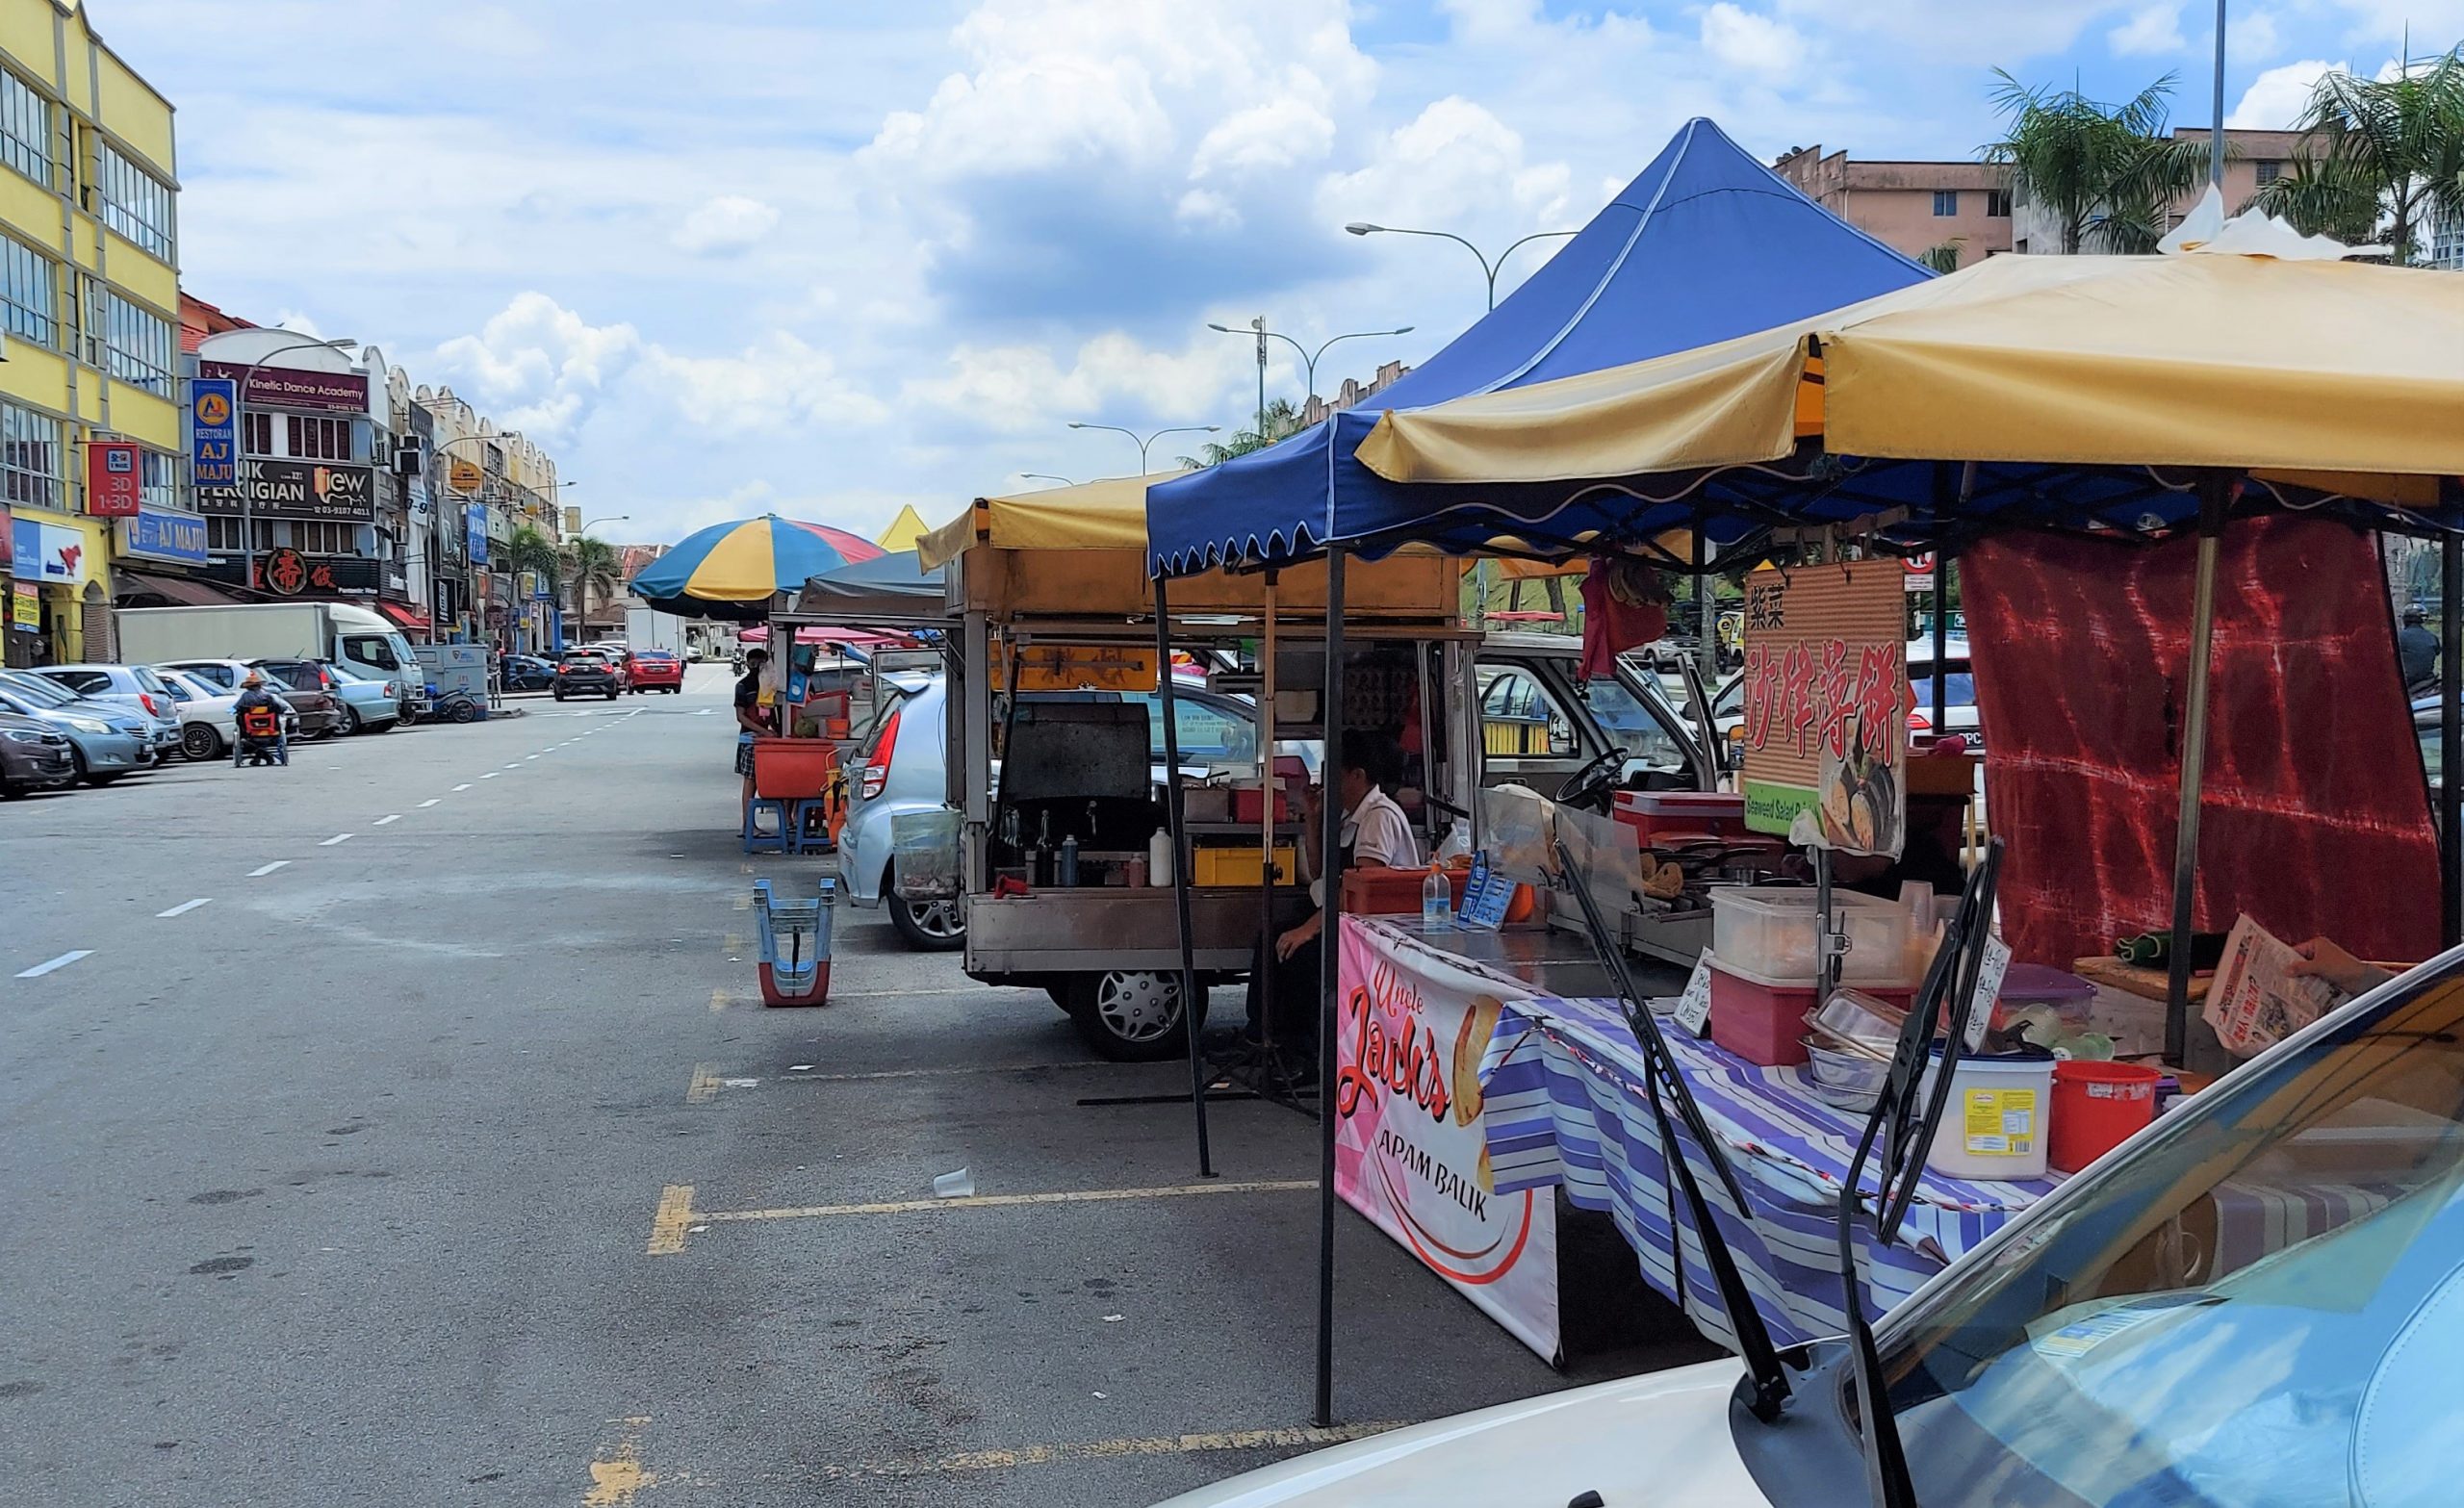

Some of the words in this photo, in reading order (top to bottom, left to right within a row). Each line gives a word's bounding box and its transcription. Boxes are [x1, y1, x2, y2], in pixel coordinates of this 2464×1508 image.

[249, 378, 282, 391] Kinetic
[284, 382, 316, 395] Dance
[318, 386, 364, 400] Academy
[195, 428, 232, 440] RESTORAN
[200, 443, 228, 460] AJ
[111, 477, 132, 492] 3D
[196, 464, 233, 480] MAJU
[159, 521, 172, 548] AJ
[175, 524, 203, 552] MAJU
[1750, 583, 1785, 631] 紫菜
[1747, 794, 1775, 819] Seaweed
[1775, 798, 1795, 822] Salad
[1373, 960, 1424, 1017] Uncle
[1338, 984, 1451, 1123] Jack's
[1378, 1129, 1431, 1181] APAM
[1435, 1163, 1487, 1222] BALIK
